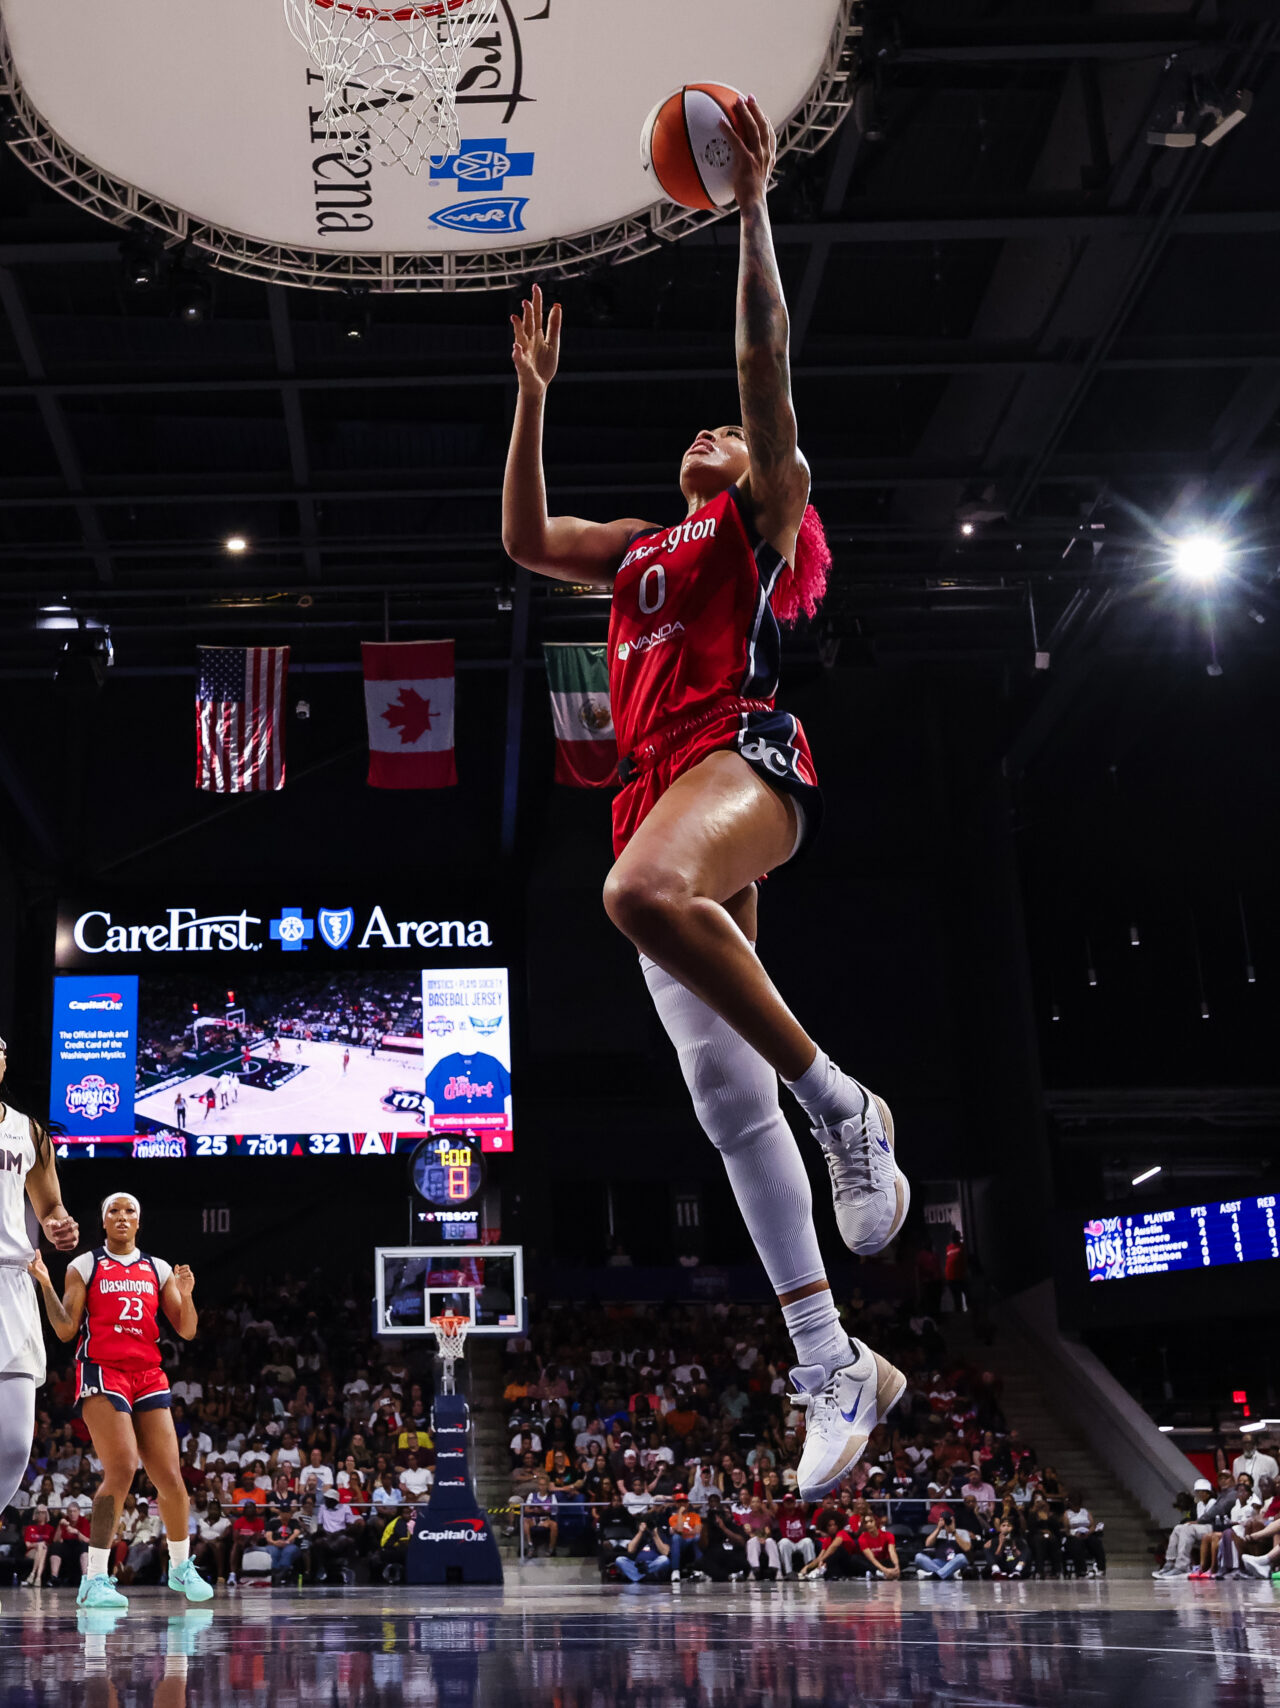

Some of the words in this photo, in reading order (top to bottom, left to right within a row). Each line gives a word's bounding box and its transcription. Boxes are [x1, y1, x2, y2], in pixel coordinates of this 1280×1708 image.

[306, 67, 415, 237] Arena
[638, 563, 666, 615] 0
[629, 620, 686, 650] VANDA
[73, 908, 262, 954] CareFirst
[357, 905, 493, 948] Arena
[428, 992, 469, 1006] BASEBALL
[472, 992, 502, 1006] JERSEY
[59, 1031, 72, 1039] The
[73, 1030, 96, 1039] Official
[97, 1030, 114, 1039] Bank
[115, 1030, 129, 1038] and
[64, 1041, 85, 1049] Credit
[85, 1040, 102, 1049] Card
[102, 1040, 110, 1048] of
[111, 1040, 122, 1048] the
[60, 1051, 100, 1061] Washington
[101, 1051, 126, 1060] Mystics
[56, 1144, 69, 1158] 4
[86, 1144, 95, 1158] 1
[196, 1135, 228, 1156] 25
[247, 1138, 287, 1155] 7:01
[309, 1134, 340, 1154] 32
[492, 1137, 503, 1149] 9
[448, 1166, 469, 1198] 8
[201, 1208, 230, 1233] 110
[434, 1211, 479, 1221] TISSOT
[1143, 1211, 1175, 1225] PLAYER
[1190, 1206, 1207, 1218] PTS
[1220, 1201, 1241, 1214] ASST
[1257, 1196, 1276, 1208] REB
[1133, 1224, 1163, 1236] Austin
[1231, 1213, 1238, 1223] 1
[1265, 1207, 1273, 1218] 3
[1199, 1227, 1207, 1236] 4
[1232, 1222, 1239, 1233] 0
[1267, 1217, 1274, 1228] 0
[1200, 1236, 1208, 1246] 4
[1234, 1232, 1240, 1241] 1
[1268, 1227, 1276, 1238] 0
[1201, 1246, 1209, 1256] 0
[1234, 1242, 1242, 1252] 0
[1271, 1237, 1278, 1247] 1
[1203, 1255, 1210, 1266] 0
[1237, 1251, 1243, 1262] 1
[1271, 1247, 1279, 1258] 3
[100, 1278, 154, 1296] Washington
[118, 1296, 144, 1321] 23
